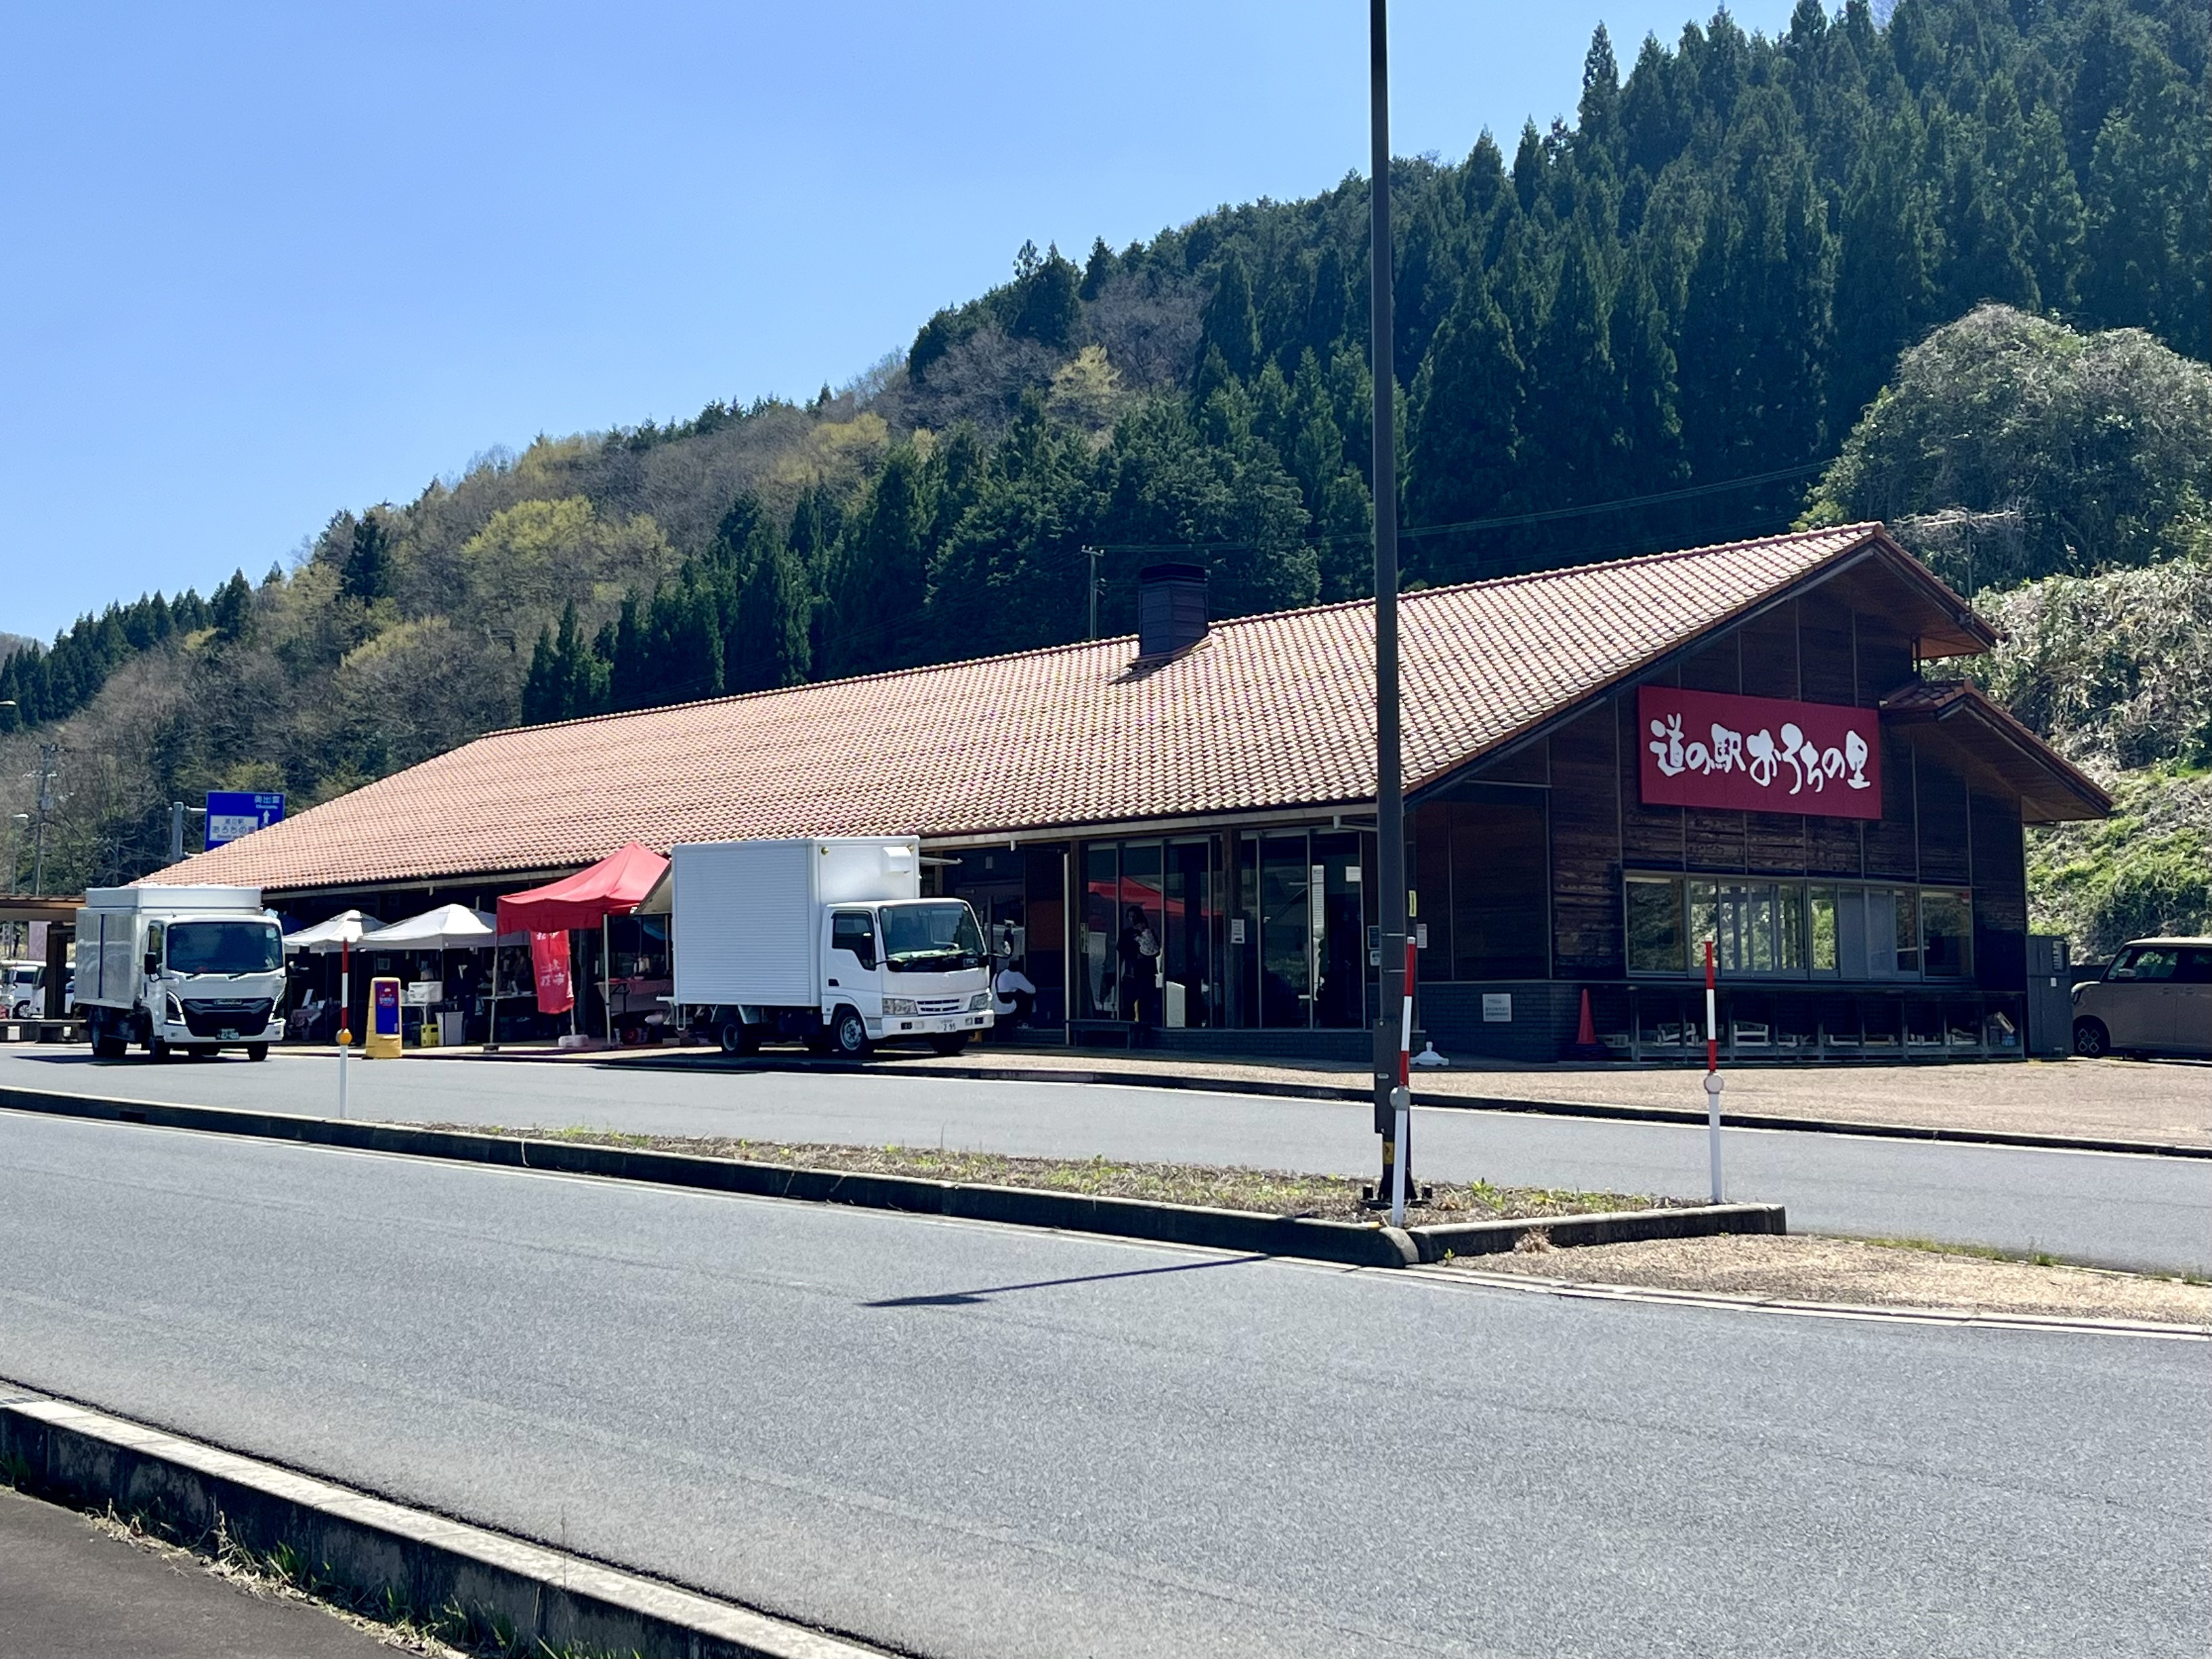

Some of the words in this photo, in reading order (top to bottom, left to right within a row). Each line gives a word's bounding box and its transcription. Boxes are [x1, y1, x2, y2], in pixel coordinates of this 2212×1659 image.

[1649, 713, 1871, 795] 道の駅おろちの里
